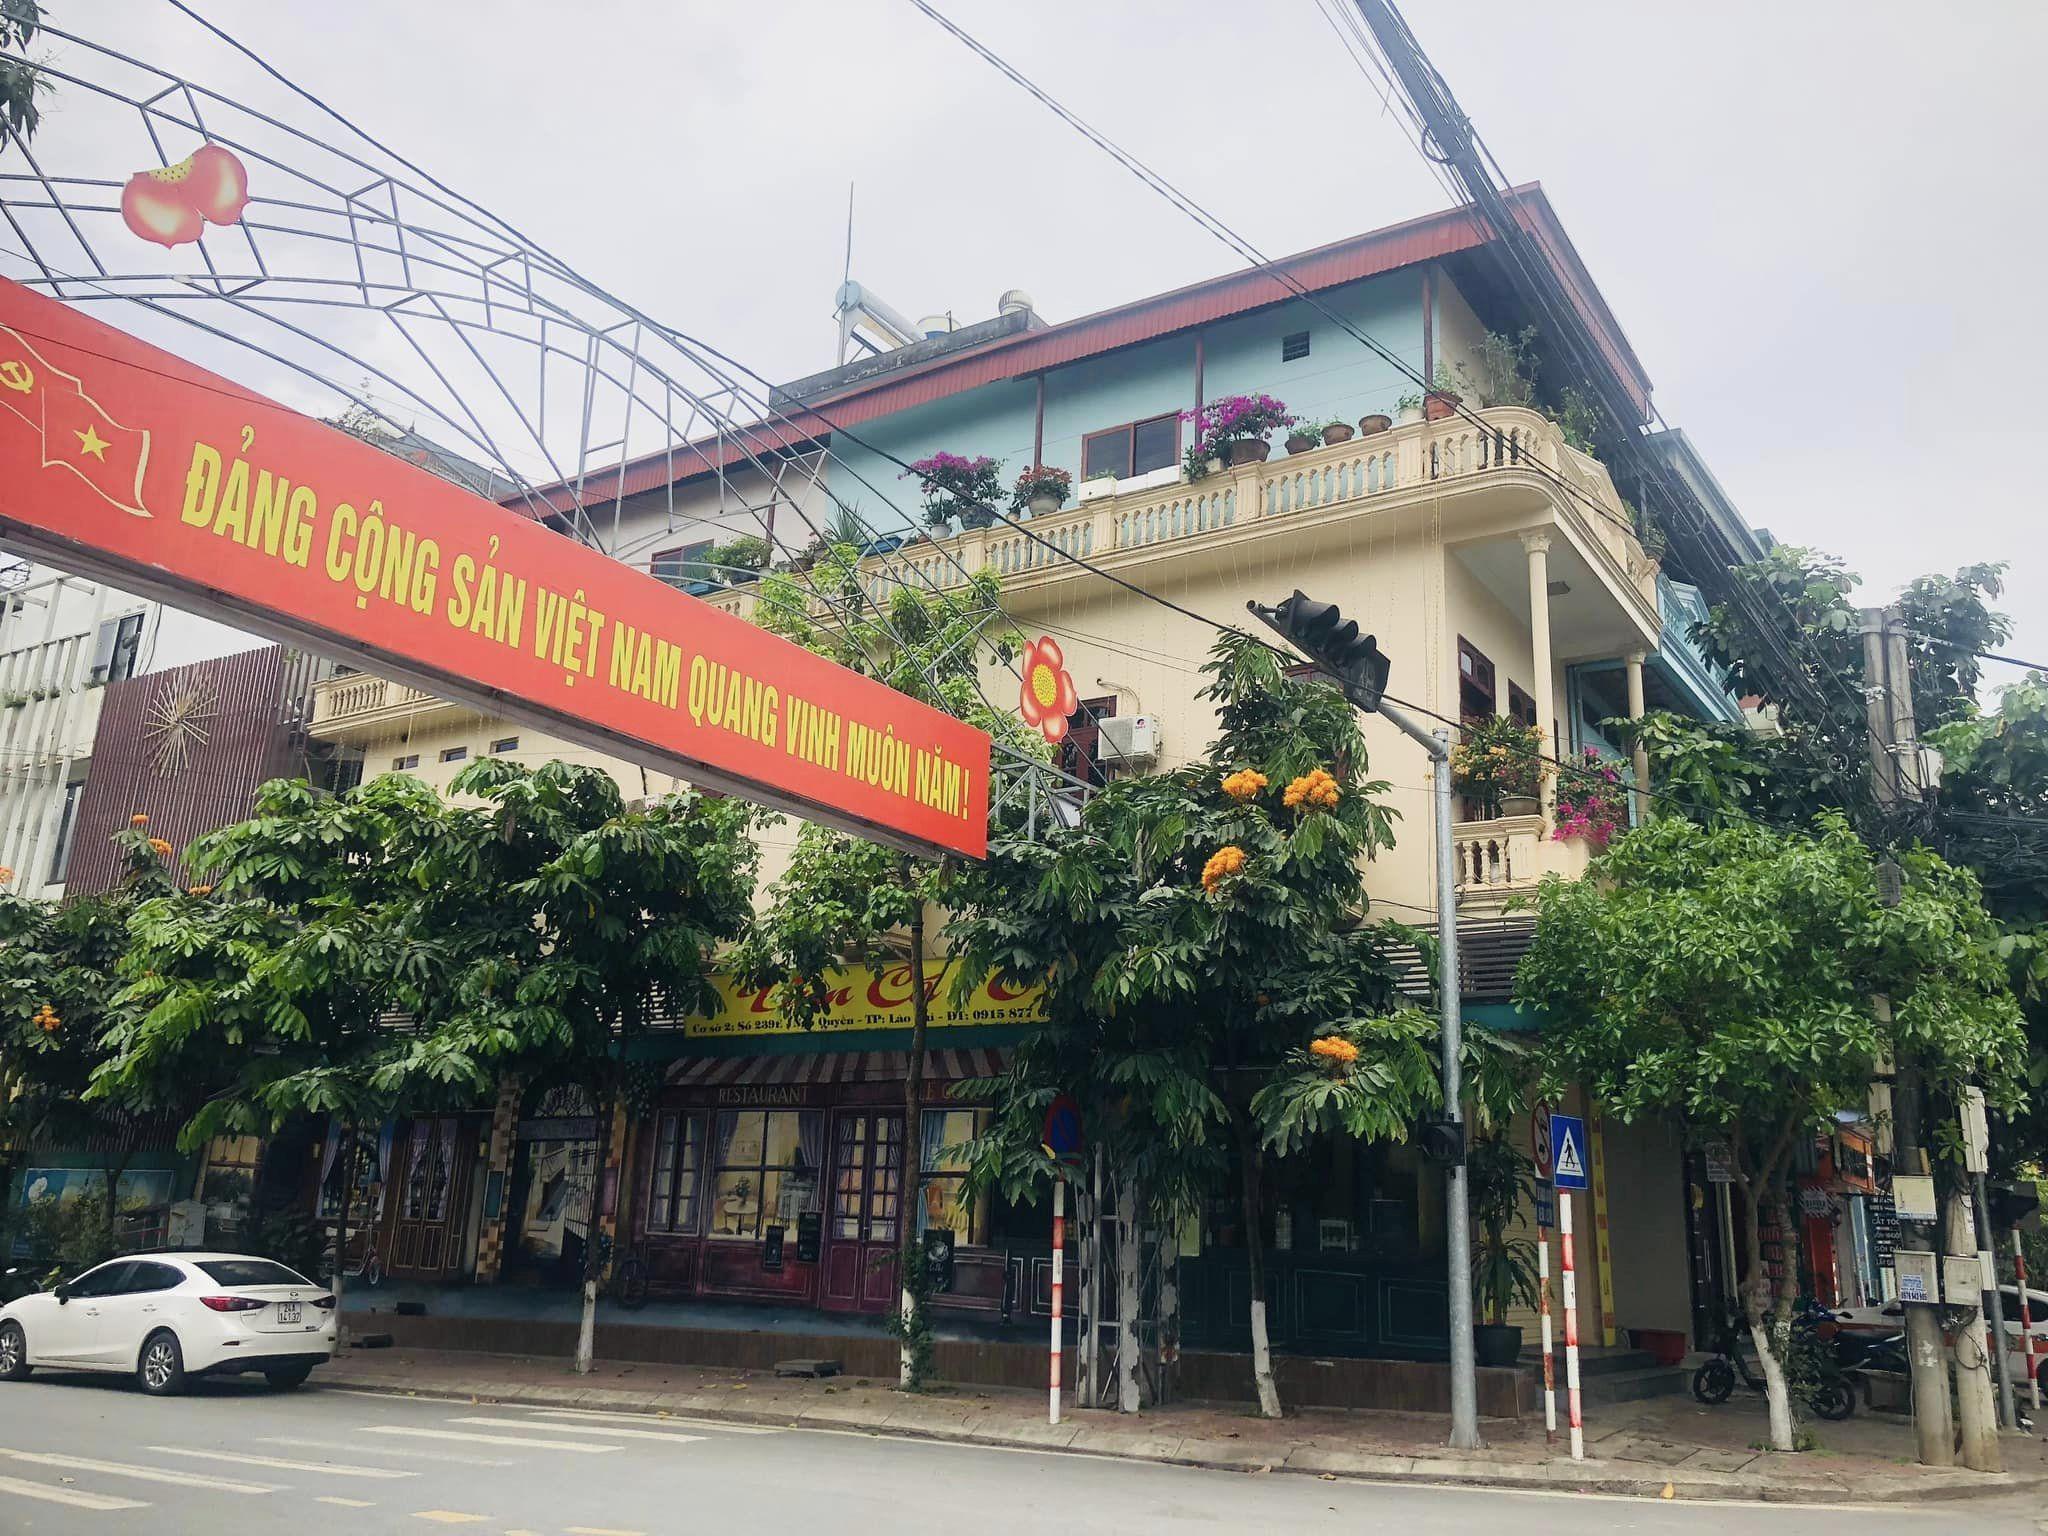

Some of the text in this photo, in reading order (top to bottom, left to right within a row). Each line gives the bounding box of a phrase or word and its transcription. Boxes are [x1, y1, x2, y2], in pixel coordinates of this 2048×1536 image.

[181, 425, 317, 568] ĐẢNG
[326, 501, 440, 615] CỘNG
[447, 535, 528, 648] SẢN
[535, 588, 606, 687] VIỆT
[609, 620, 682, 710] NAM
[687, 655, 778, 748] QUANG
[786, 694, 841, 773] VINH
[845, 722, 911, 799] MUÔN
[864, 1013, 885, 1024] TP:
[972, 1008, 1004, 1020] 0915
[1009, 1007, 1032, 1019] 877
[718, 1086, 809, 1105] RESTAURANT
